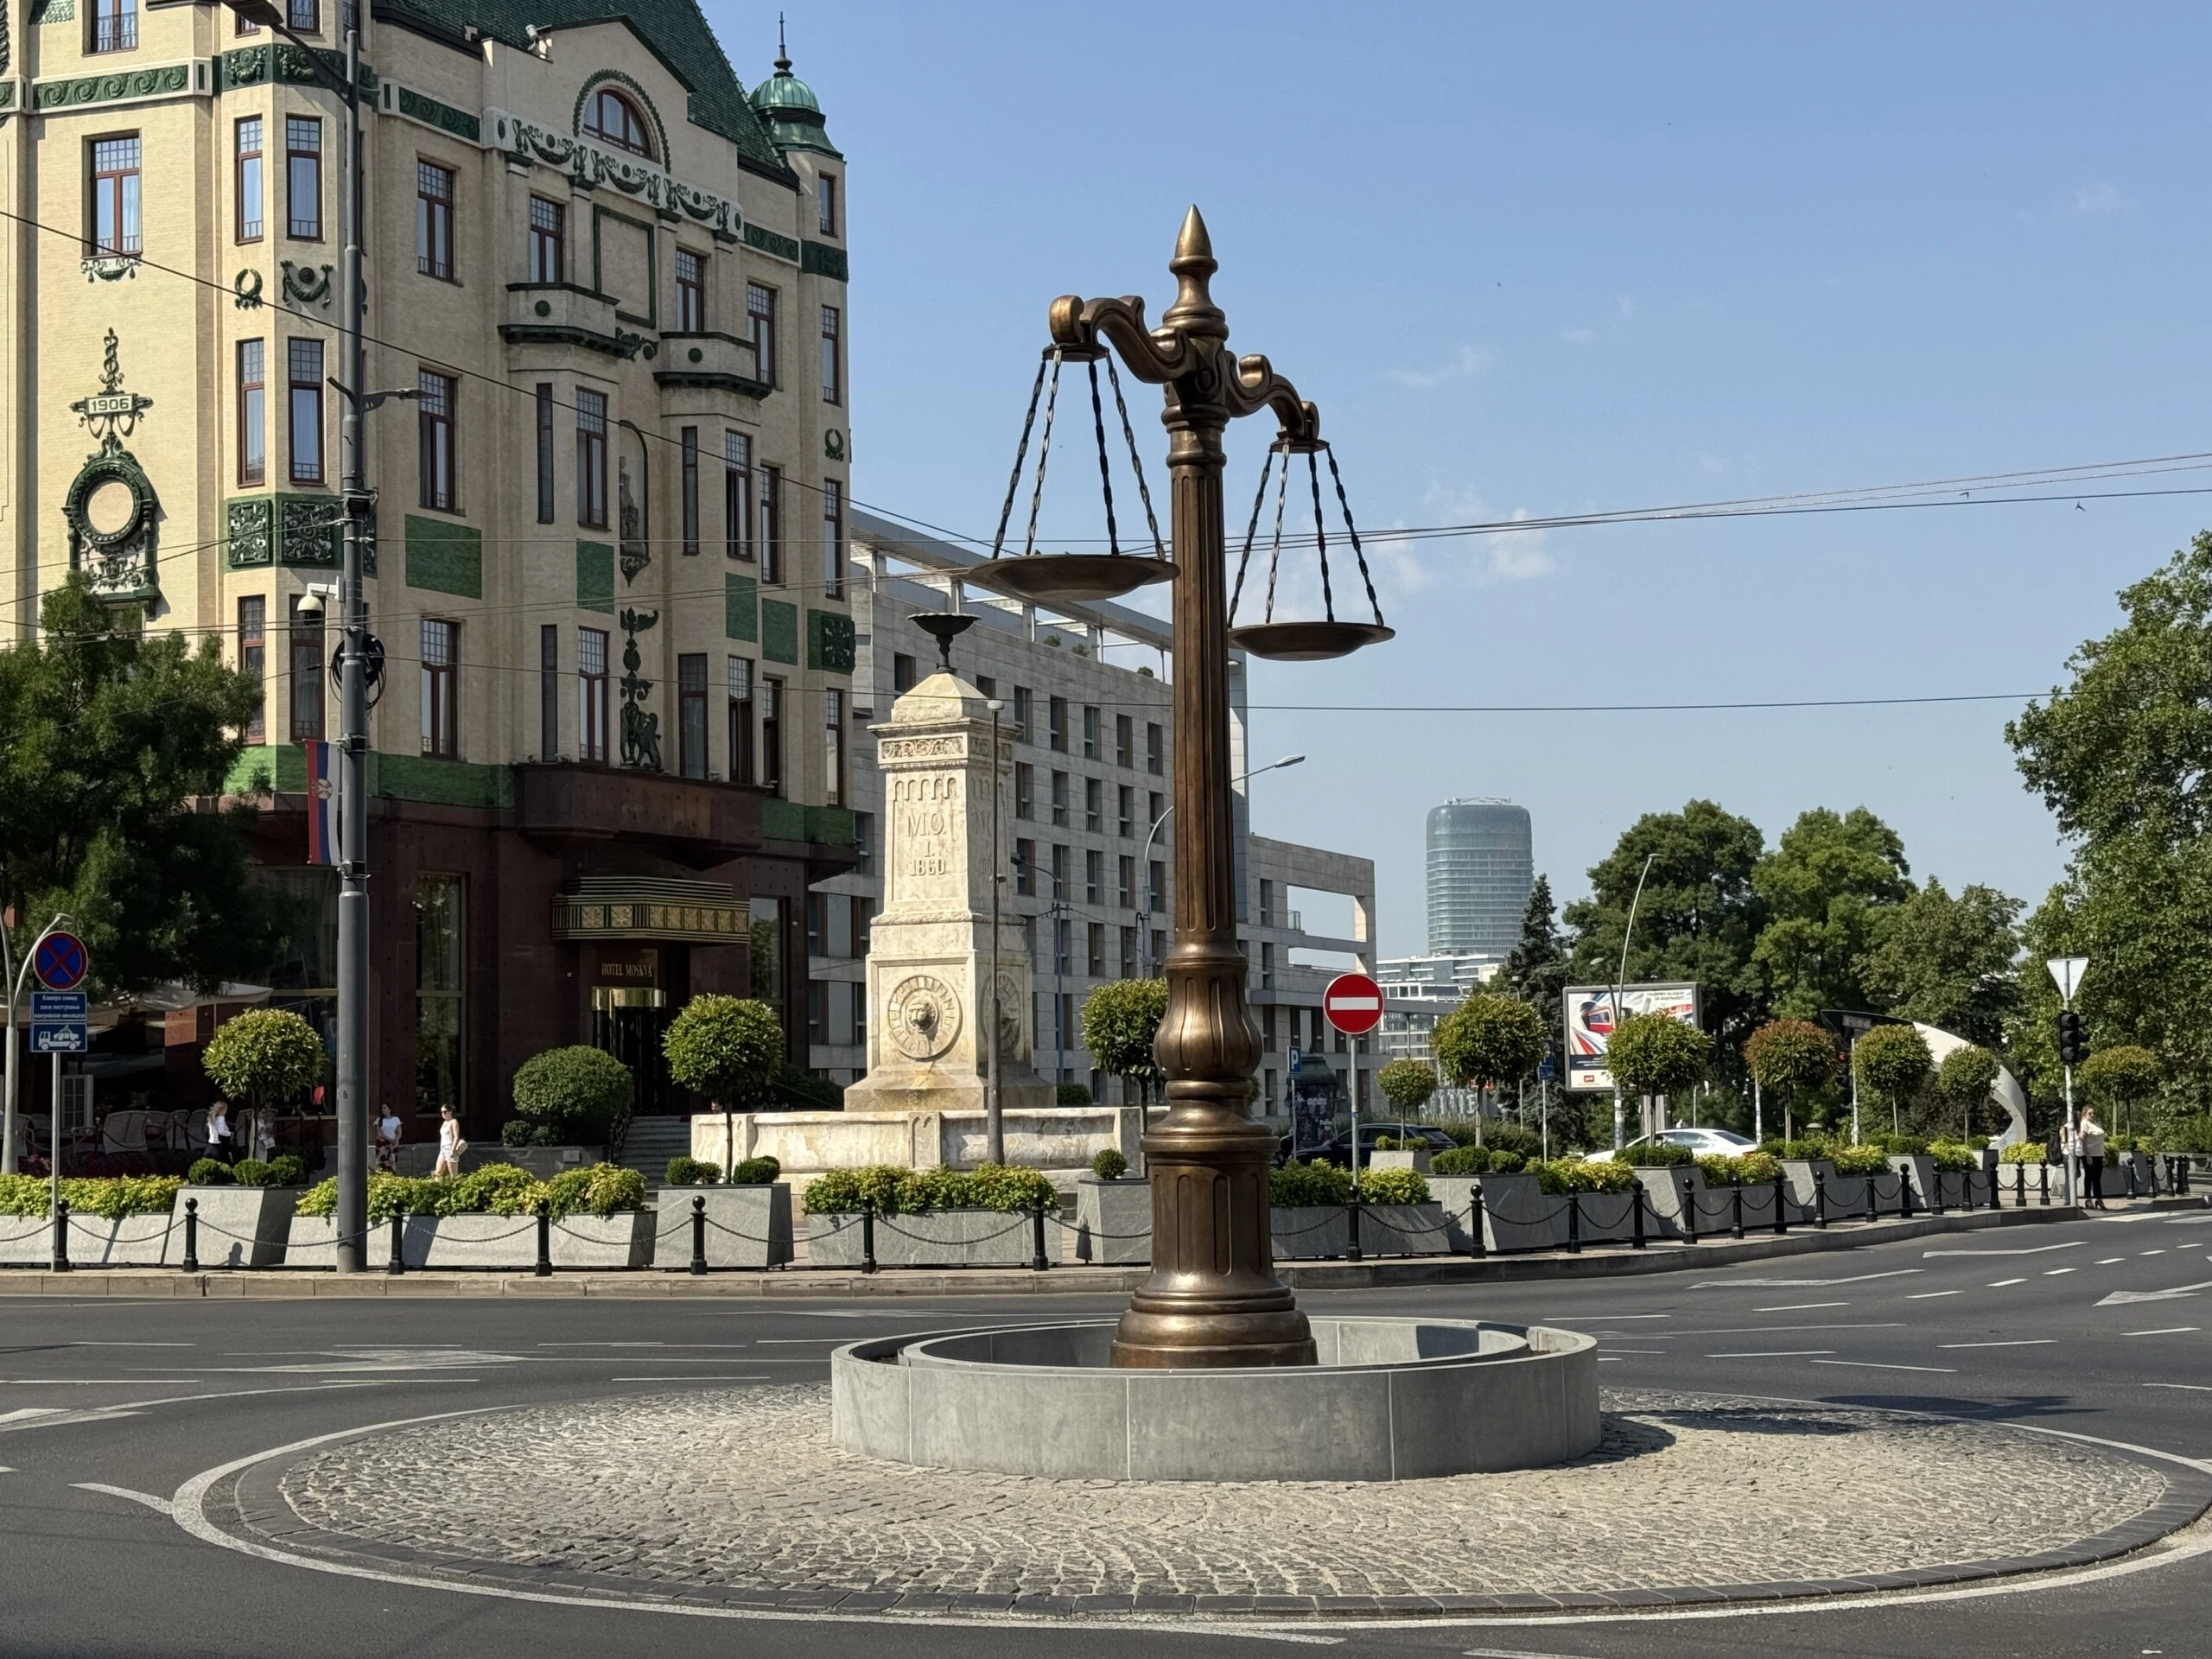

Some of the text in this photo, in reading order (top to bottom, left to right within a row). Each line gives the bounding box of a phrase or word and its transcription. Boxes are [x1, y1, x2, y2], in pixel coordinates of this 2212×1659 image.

[92, 397, 129, 412] 1906
[601, 963, 652, 977] HOTEL MOSKVA
[1291, 1049, 1299, 1071] P
